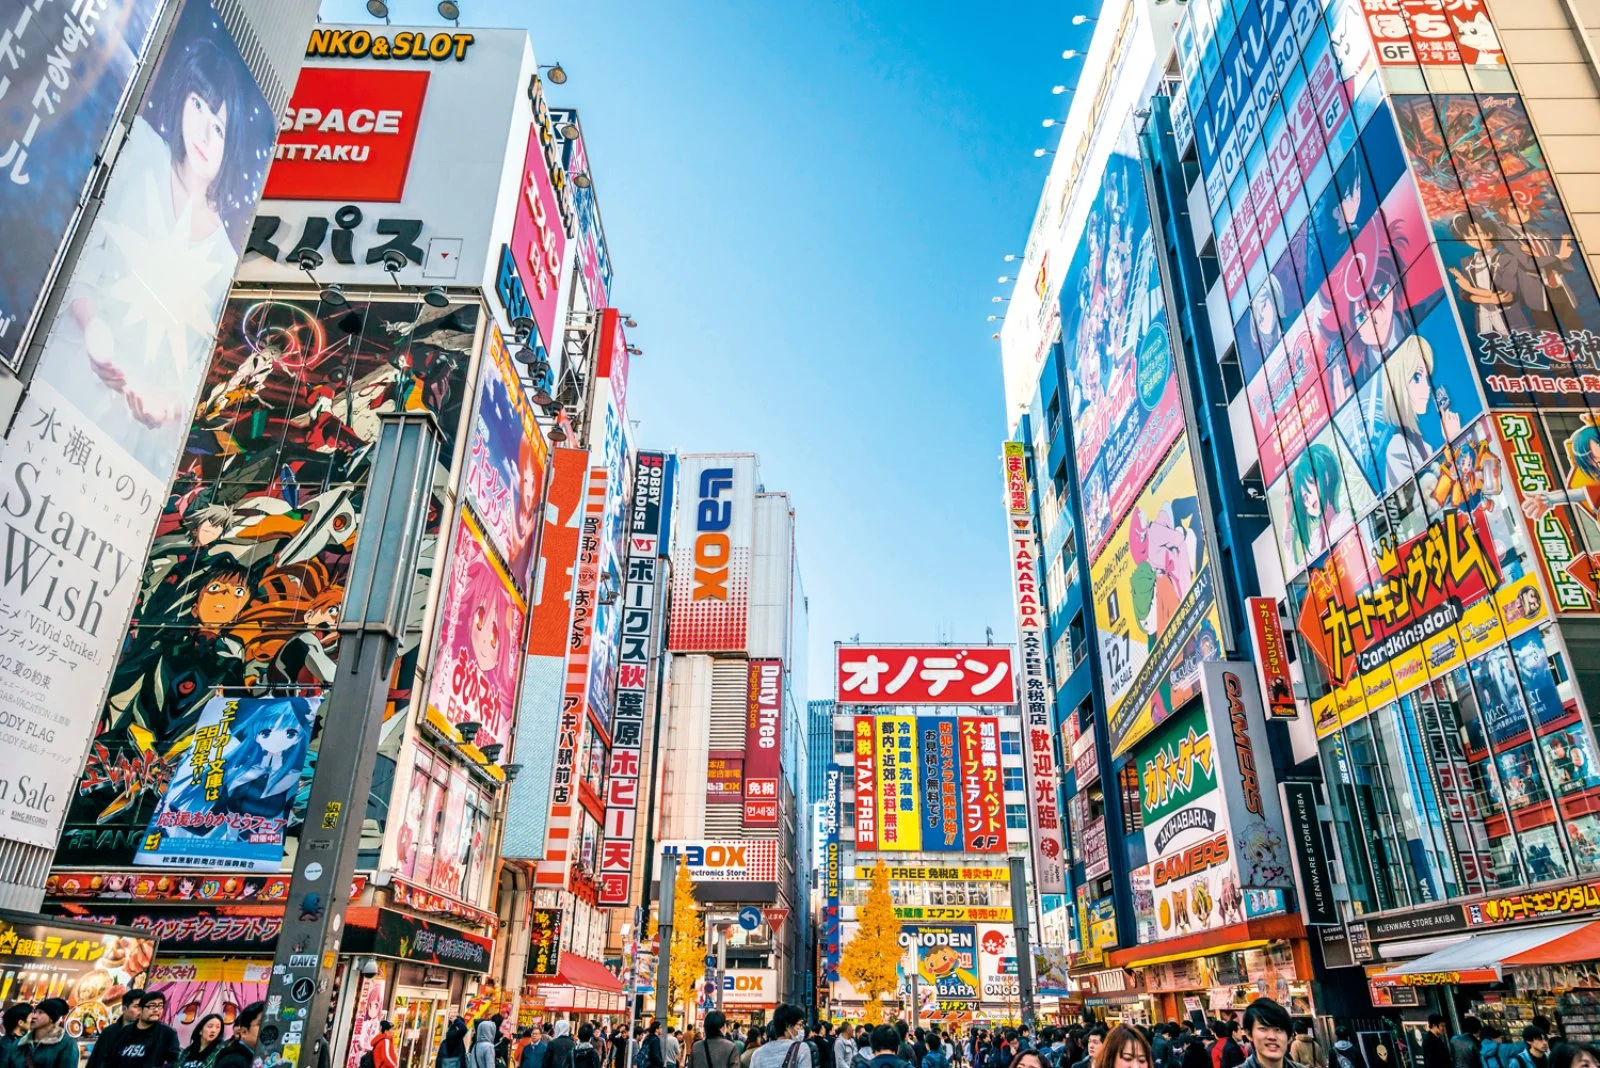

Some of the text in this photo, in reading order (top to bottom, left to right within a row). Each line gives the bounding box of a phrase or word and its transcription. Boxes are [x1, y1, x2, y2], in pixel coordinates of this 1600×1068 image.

[1383, 45, 1411, 60] 6F
[1324, 99, 1343, 131] 6F
[30, 407, 153, 516] 水瀬いのり
[647, 456, 664, 507] HOBBY
[633, 455, 651, 531] PARADISE
[1, 460, 135, 598] Starry
[4, 521, 105, 638] Wish
[1015, 539, 1038, 628] TAKARADA
[841, 649, 1009, 697] オノデン
[1106, 629, 1130, 680] 12.7
[758, 664, 780, 749] Duty Free
[1026, 678, 1048, 726] 免税商店
[26, 721, 56, 744] FLAG
[205, 700, 240, 801] スニーカー文庫は
[553, 697, 581, 804] アキバ駅前店
[1222, 671, 1266, 821] GAMERS
[748, 780, 776, 795] 免税
[856, 720, 874, 843] 免税 TAX FREE
[897, 721, 914, 812] 冷蔵庫 洗濯機
[924, 730, 941, 829] お見積り無料です
[1030, 729, 1058, 831] 歓迎光臨
[13, 774, 56, 814] Sale
[828, 770, 839, 835] Panasonic
[971, 835, 999, 850] 4F
[1153, 835, 1230, 887] GAMERS
[1296, 792, 1325, 914] ALIENWARE STORE AKIBA
[726, 868, 747, 877] Store
[828, 842, 839, 898] ONODEN
[891, 868, 926, 879] FREE
[928, 867, 959, 879] 免税店
[766, 913, 785, 921] 止まれ
[927, 908, 965, 919] エアコン
[1376, 920, 1411, 933] ALIENWARE
[1412, 917, 1434, 928] STORE
[1434, 913, 1456, 924] AKIBA
[14, 934, 105, 961] 銀座ライオン
[290, 955, 318, 967] DAVE
